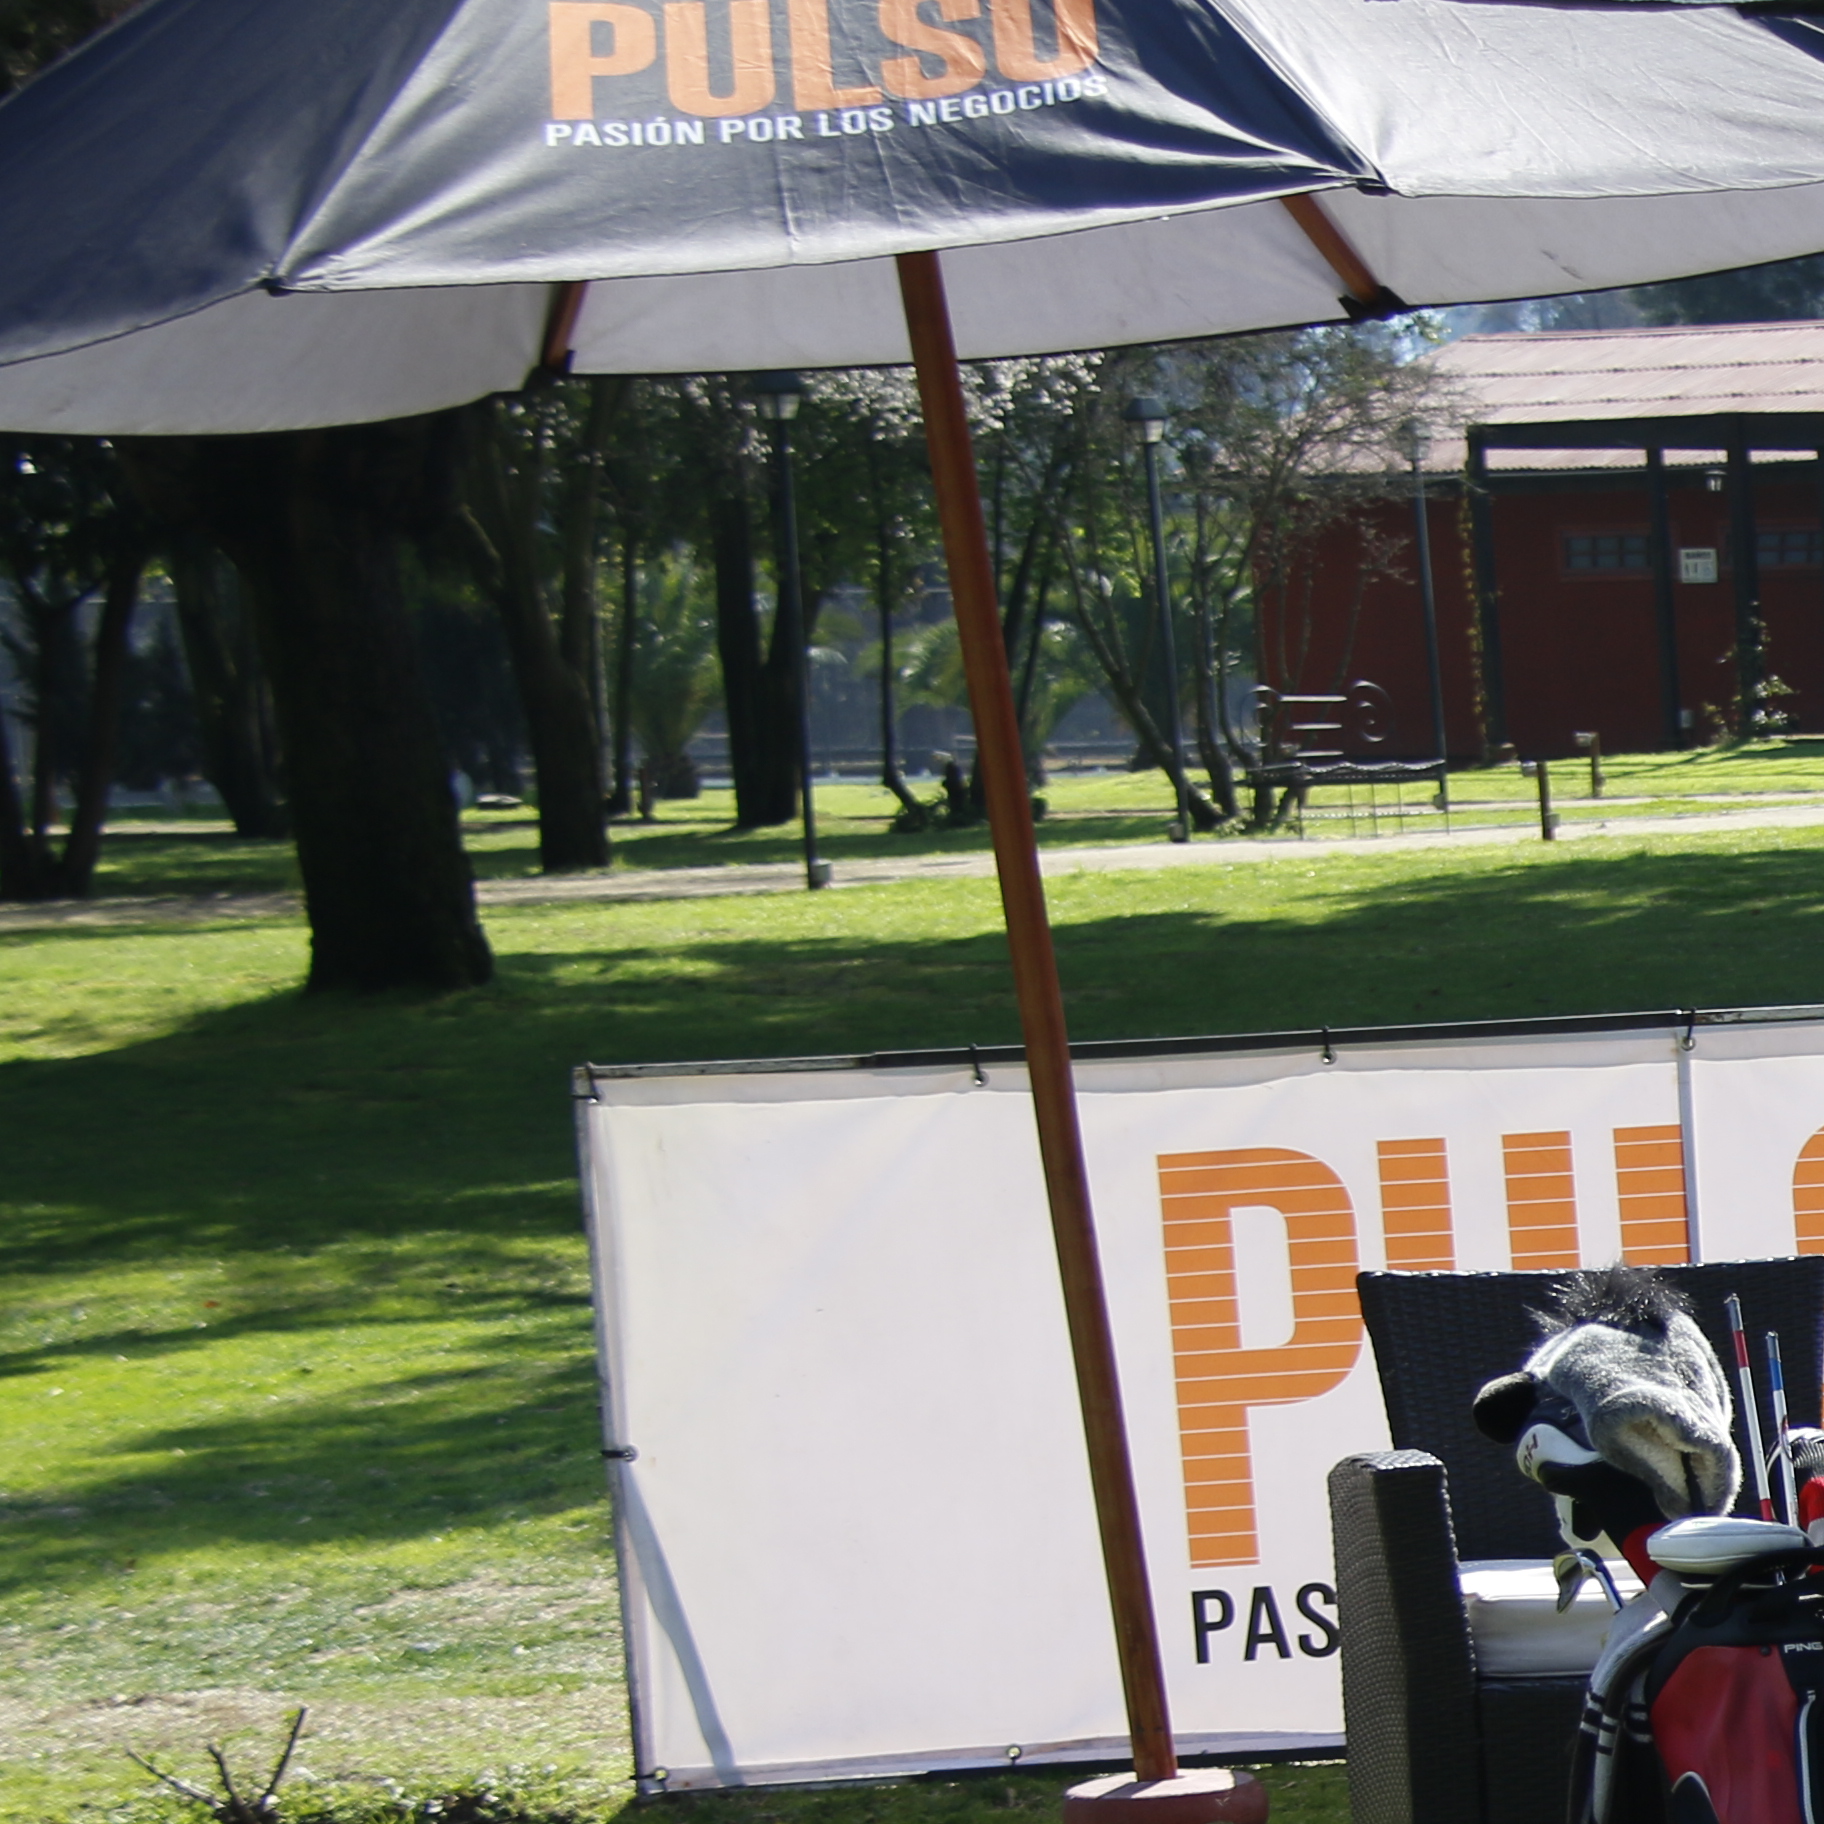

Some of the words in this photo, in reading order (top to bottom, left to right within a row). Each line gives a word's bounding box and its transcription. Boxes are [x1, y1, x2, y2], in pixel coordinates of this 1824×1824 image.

[549, 0, 1100, 121] PULSO
[545, 117, 705, 147] PASIÓN
[719, 116, 804, 143] POR
[817, 107, 895, 137] LOS
[907, 75, 1109, 127] NEGOCIOS
[1191, 1582, 1341, 1665] PAS
[1783, 1641, 1824, 1654] PING
